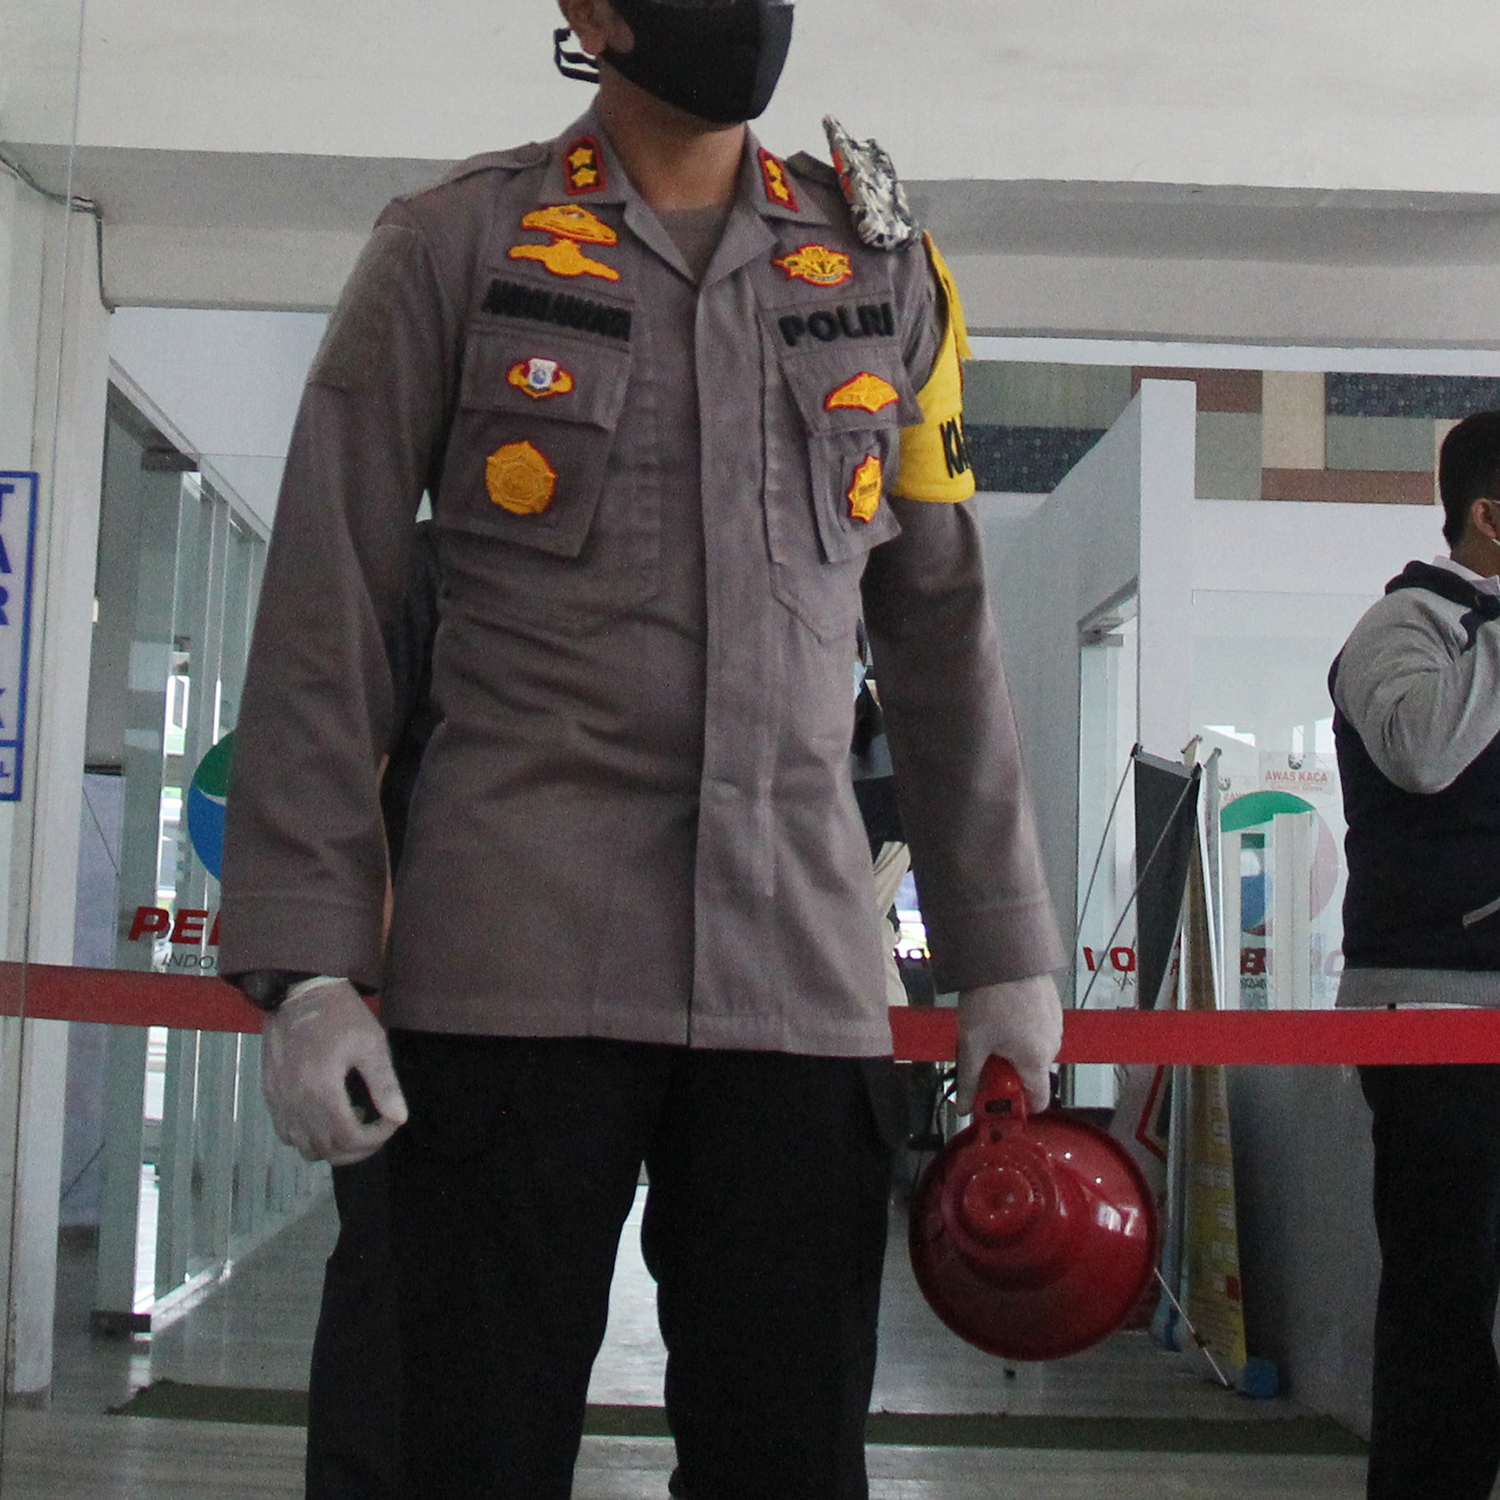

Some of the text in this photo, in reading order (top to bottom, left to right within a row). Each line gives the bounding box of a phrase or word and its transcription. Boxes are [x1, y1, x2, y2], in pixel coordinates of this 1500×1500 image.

[778, 302, 895, 347] POLRI
[1265, 769, 1329, 784] AWAS KACA
